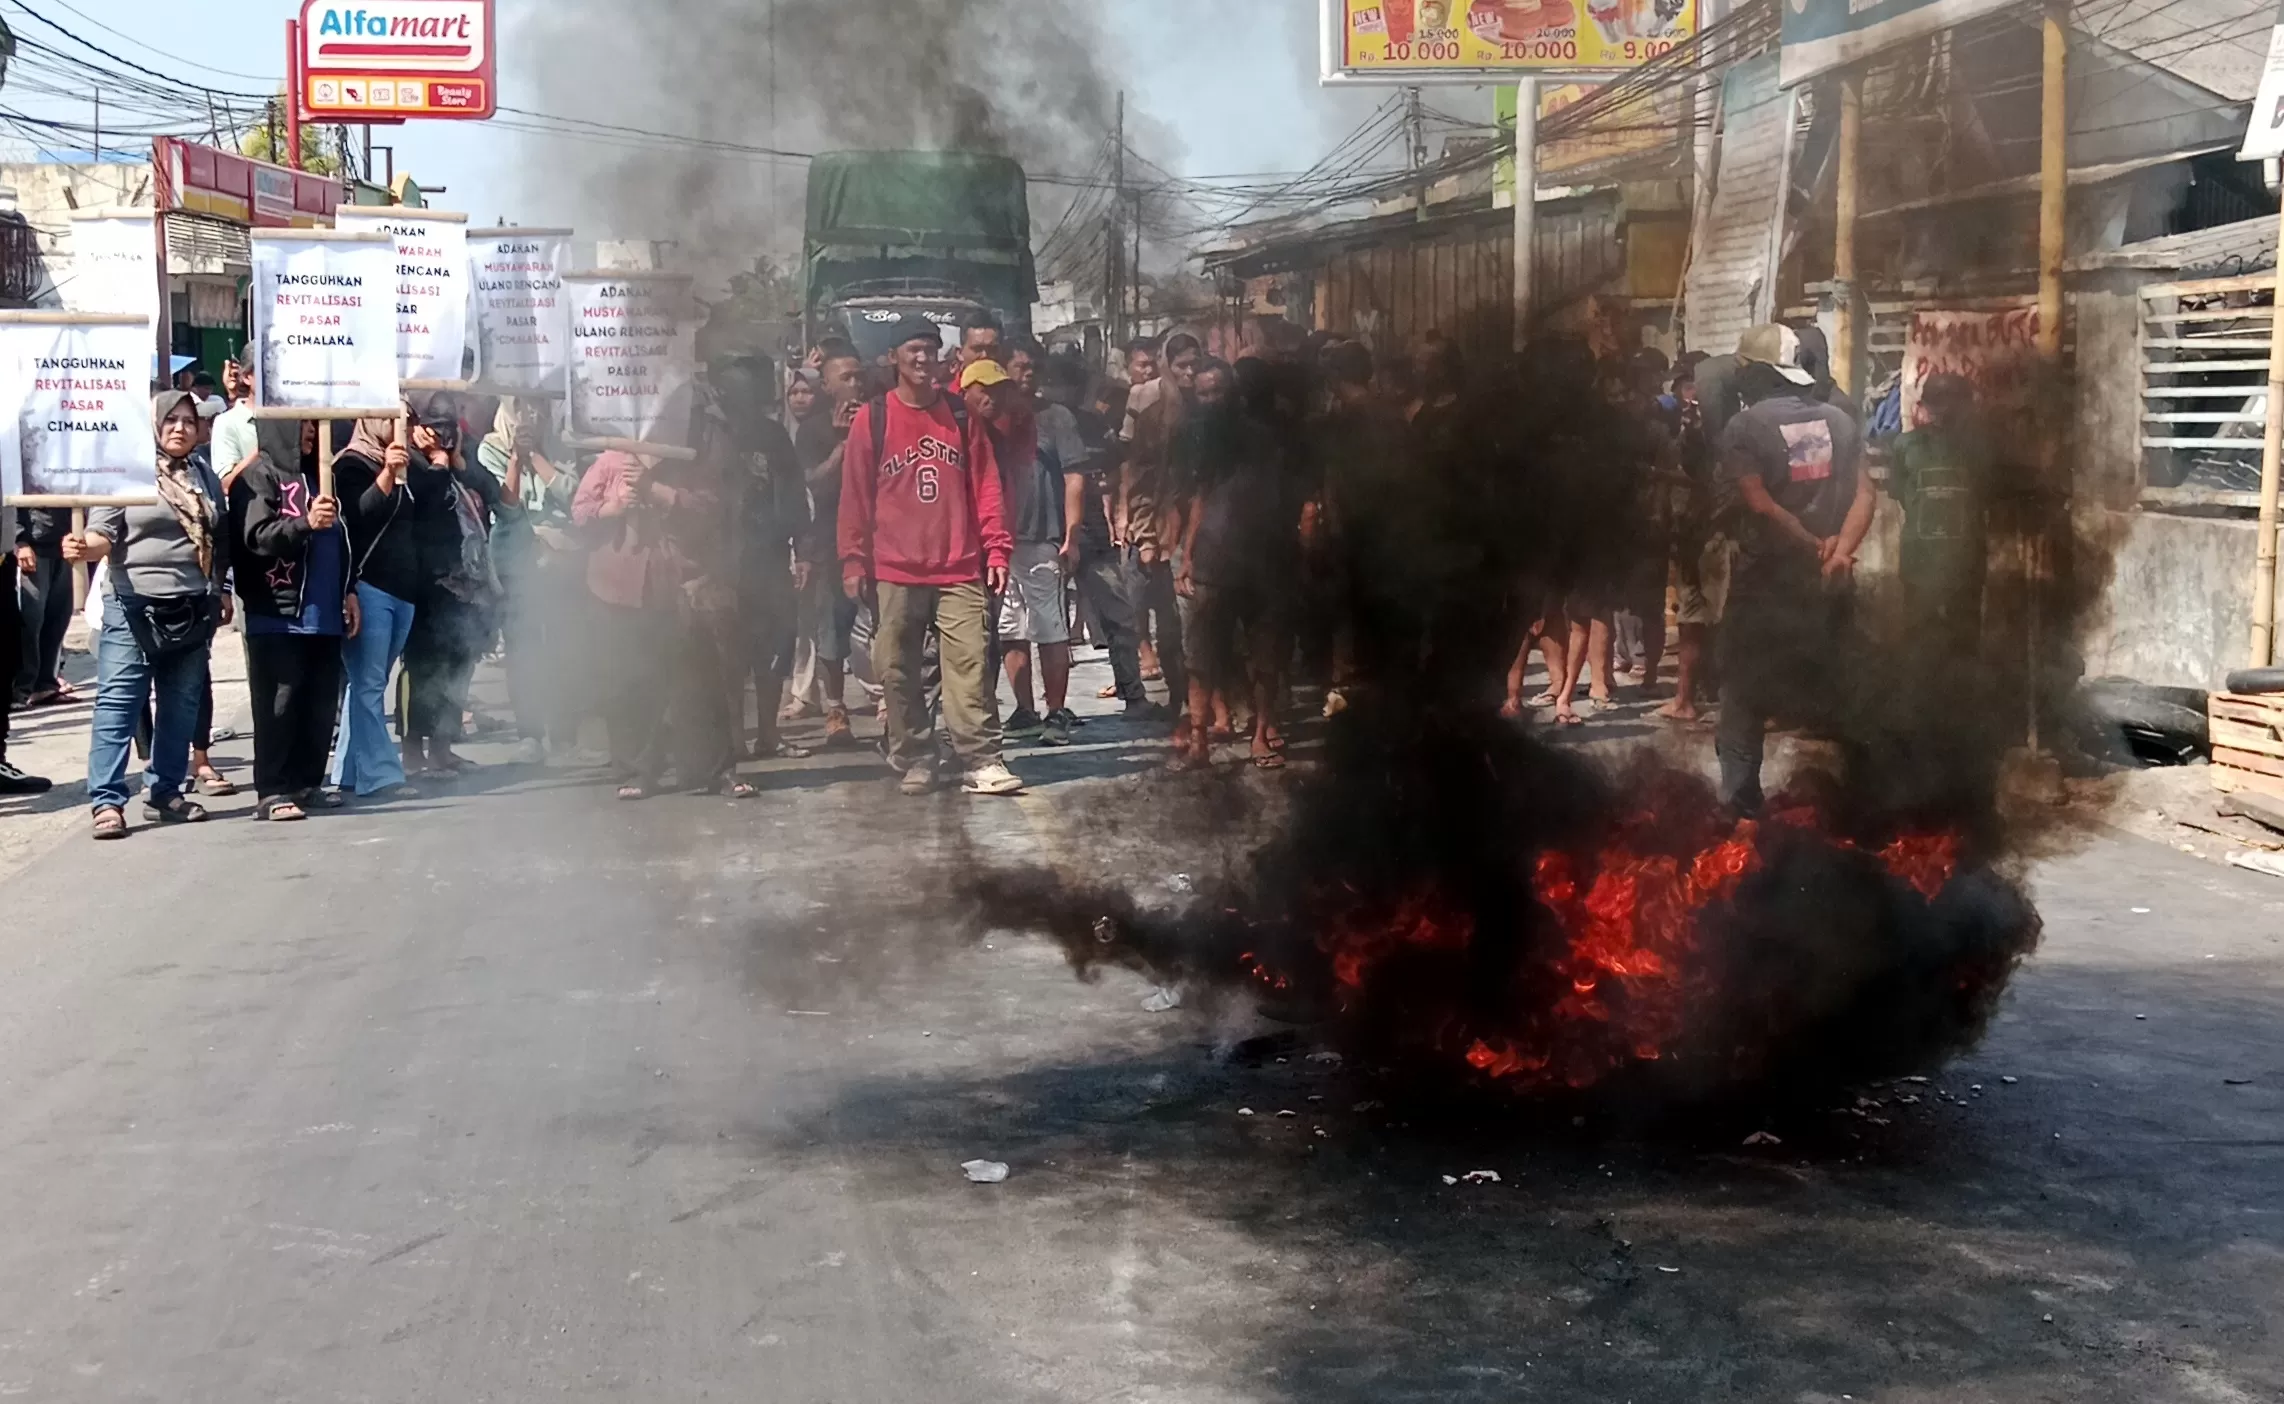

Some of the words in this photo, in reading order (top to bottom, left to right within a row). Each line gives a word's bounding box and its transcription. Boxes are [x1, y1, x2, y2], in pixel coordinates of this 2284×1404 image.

[319, 9, 471, 38] Alfamart
[1383, 42, 1459, 60] 10.000
[1500, 41, 1577, 59] 10.000
[437, 85, 472, 99] Beauty
[441, 95, 467, 106] Store
[397, 245, 442, 257] WARAH
[497, 244, 540, 254] ADAKAN
[484, 262, 554, 273] MUSYAWARAH
[276, 274, 362, 286] TANGGUHKAN
[479, 280, 512, 291] ULANG
[515, 280, 562, 291] RENCANA
[600, 286, 651, 298] ADAKAN
[277, 293, 362, 307] REVITALISASI
[583, 306, 670, 318] MUSYAWARAH
[300, 315, 341, 326] PASAR
[506, 316, 538, 327] PASAR
[574, 326, 617, 338] ULANG
[620, 326, 678, 338] RENCANA
[287, 334, 355, 347] CIMALAKA
[585, 345, 668, 358] REVITALISASI
[34, 358, 125, 370] TANGGUHKAN
[607, 365, 648, 377] PASAR
[35, 378, 127, 391] REVITALISASI
[596, 385, 660, 397] CIMALAKA
[61, 400, 104, 411] PASAR
[47, 421, 119, 432] CIMALAKA
[916, 465, 939, 503] 6
